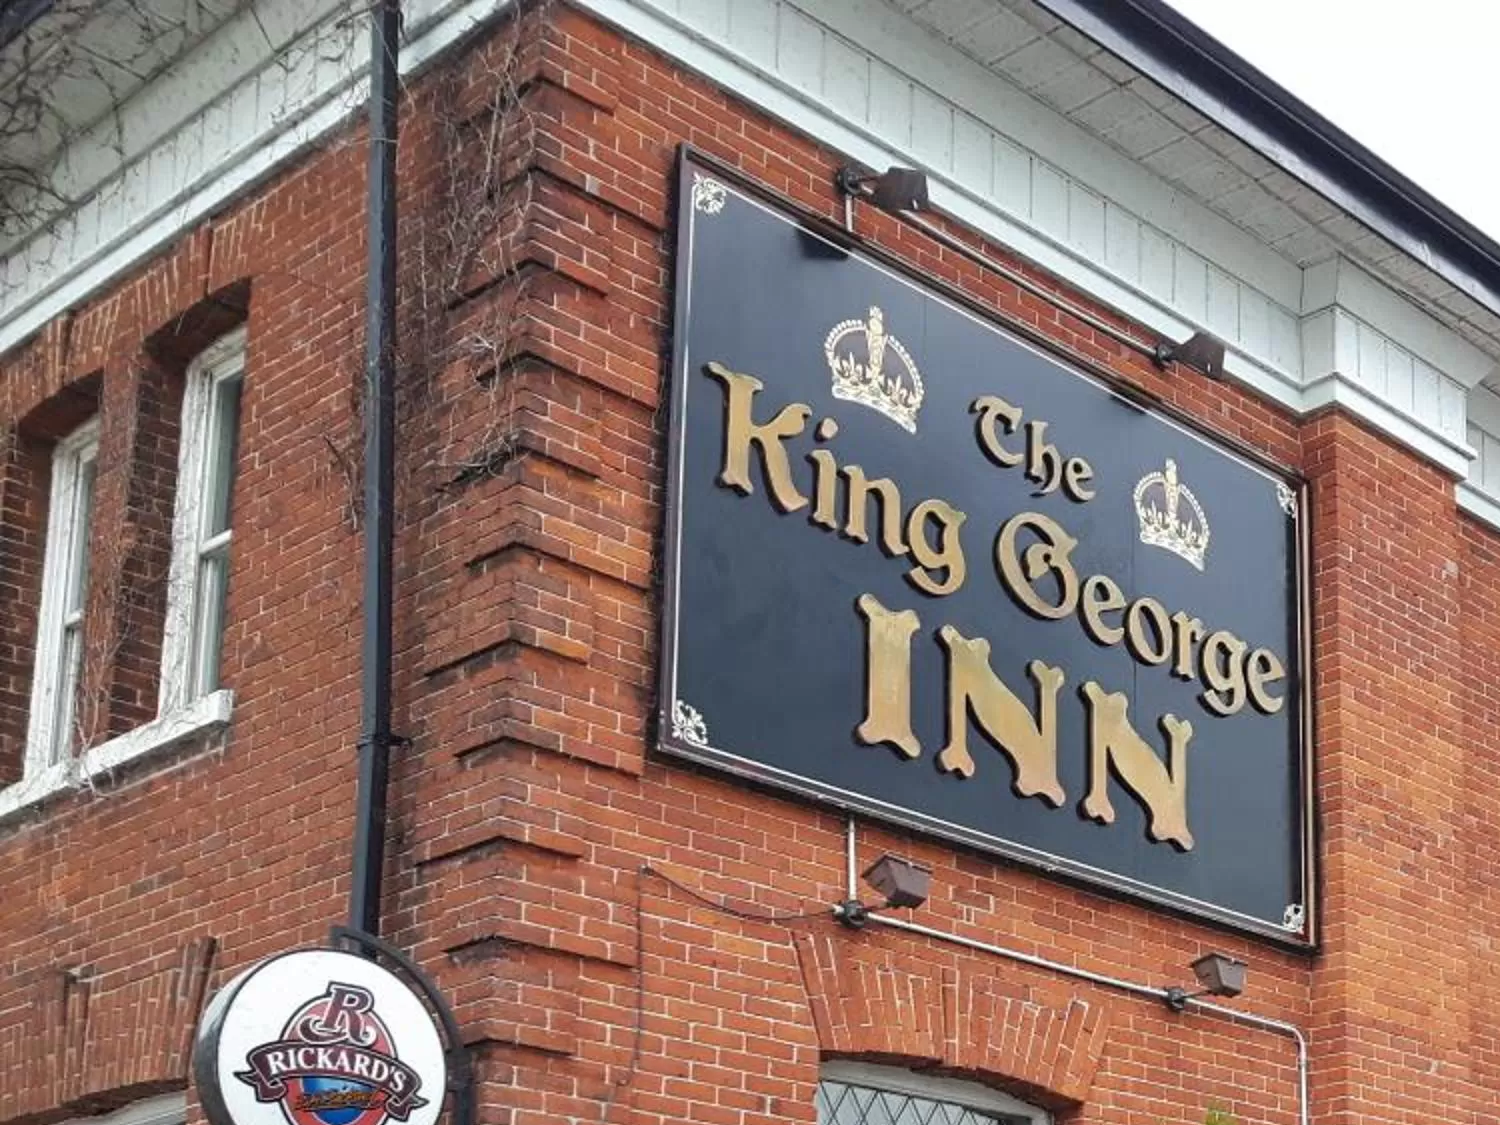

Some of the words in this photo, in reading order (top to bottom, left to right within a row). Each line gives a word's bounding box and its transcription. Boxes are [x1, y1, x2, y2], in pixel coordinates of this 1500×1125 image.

[707, 361, 967, 596] King
[999, 512, 1284, 714] George
[970, 396, 1094, 502] The
[855, 594, 1194, 852] INN
[267, 1047, 408, 1094] RICKARD'S
